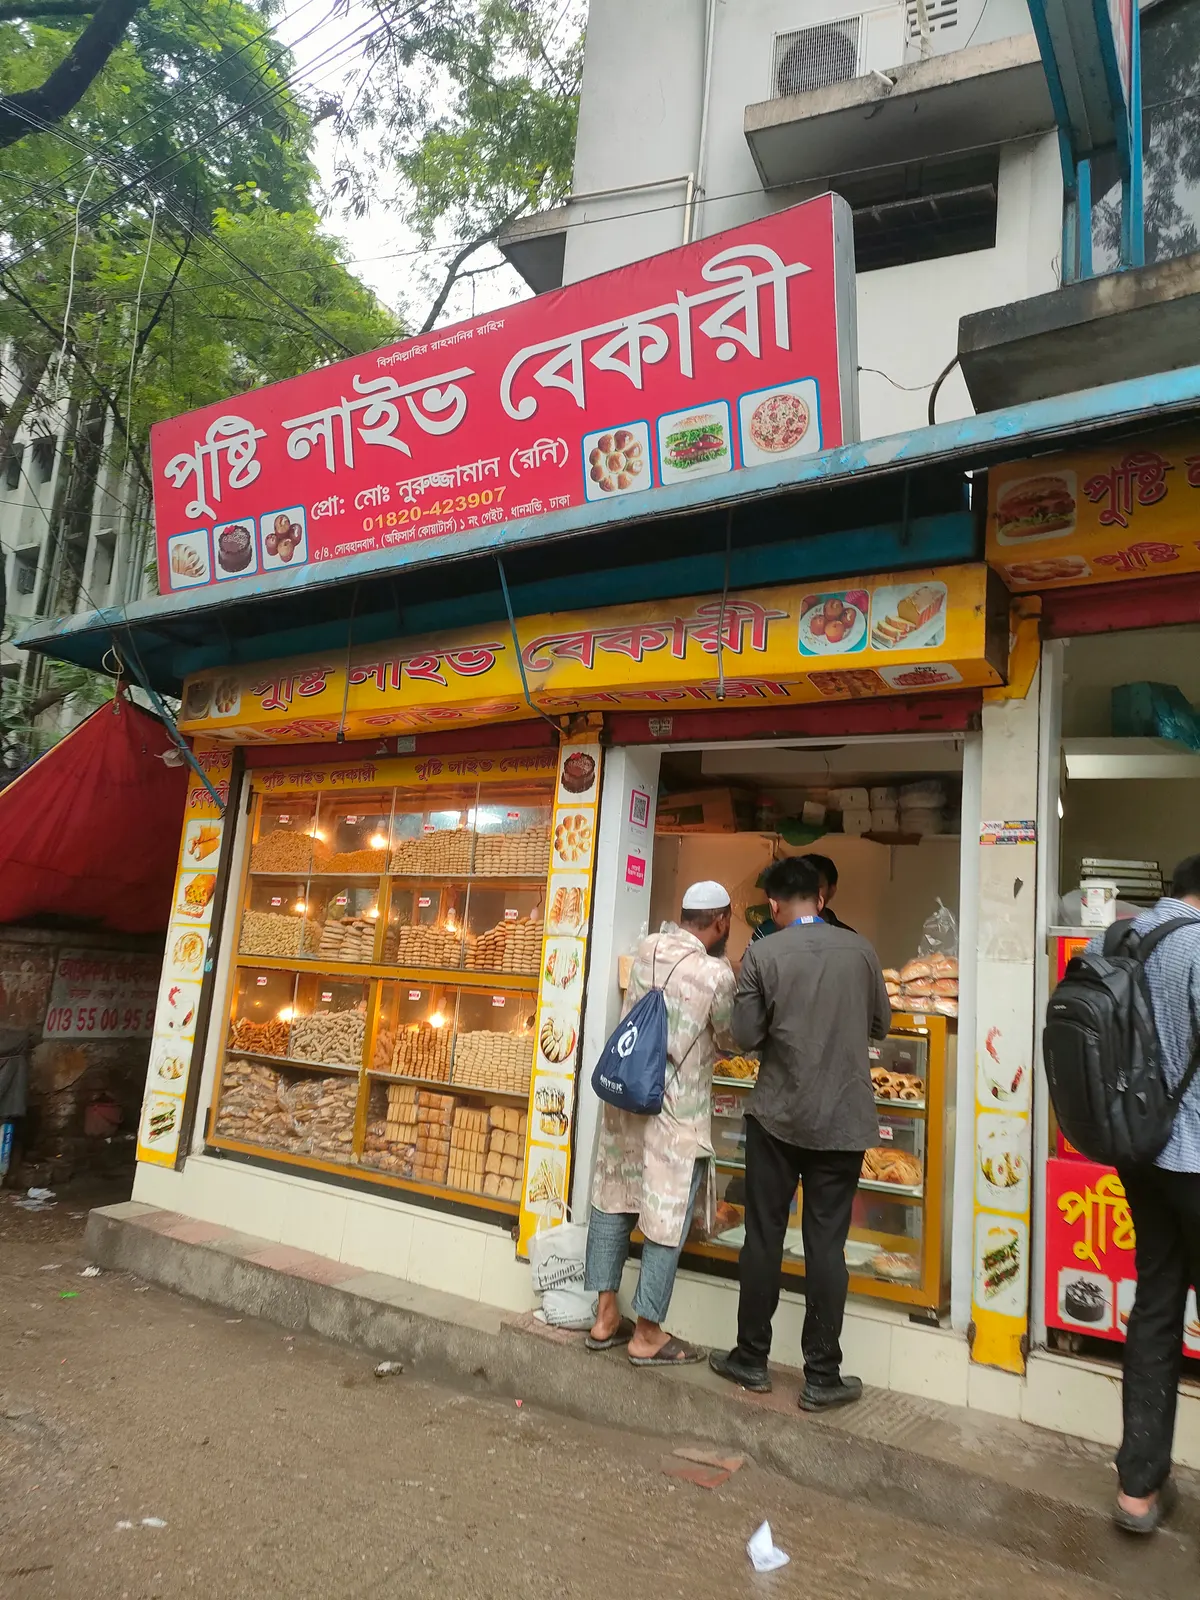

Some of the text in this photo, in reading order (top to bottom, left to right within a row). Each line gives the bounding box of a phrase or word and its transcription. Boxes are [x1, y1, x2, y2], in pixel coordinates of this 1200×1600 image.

[431, 328, 474, 351] রাহমানির
[476, 319, 505, 336] রাহিম
[163, 243, 813, 521] পুষ্টি লাইভ বেকারী
[396, 456, 501, 504] নুরুজ্জামান
[508, 437, 569, 478] (রনি)
[362, 486, 507, 532] 01820-423907
[549, 494, 571, 509] ঢাকা
[1083, 452, 1174, 529] পুষ্টি
[250, 600, 790, 712] পুষ্টি লাইভ বেকারী
[261, 762, 379, 792] পুষ্টি লাইভ বেকারী
[415, 756, 444, 781] পুষ্টি
[447, 756, 495, 777] লাইভ
[47, 1007, 73, 1032] 013
[77, 1007, 98, 1032] 55
[101, 1008, 119, 1031] 00
